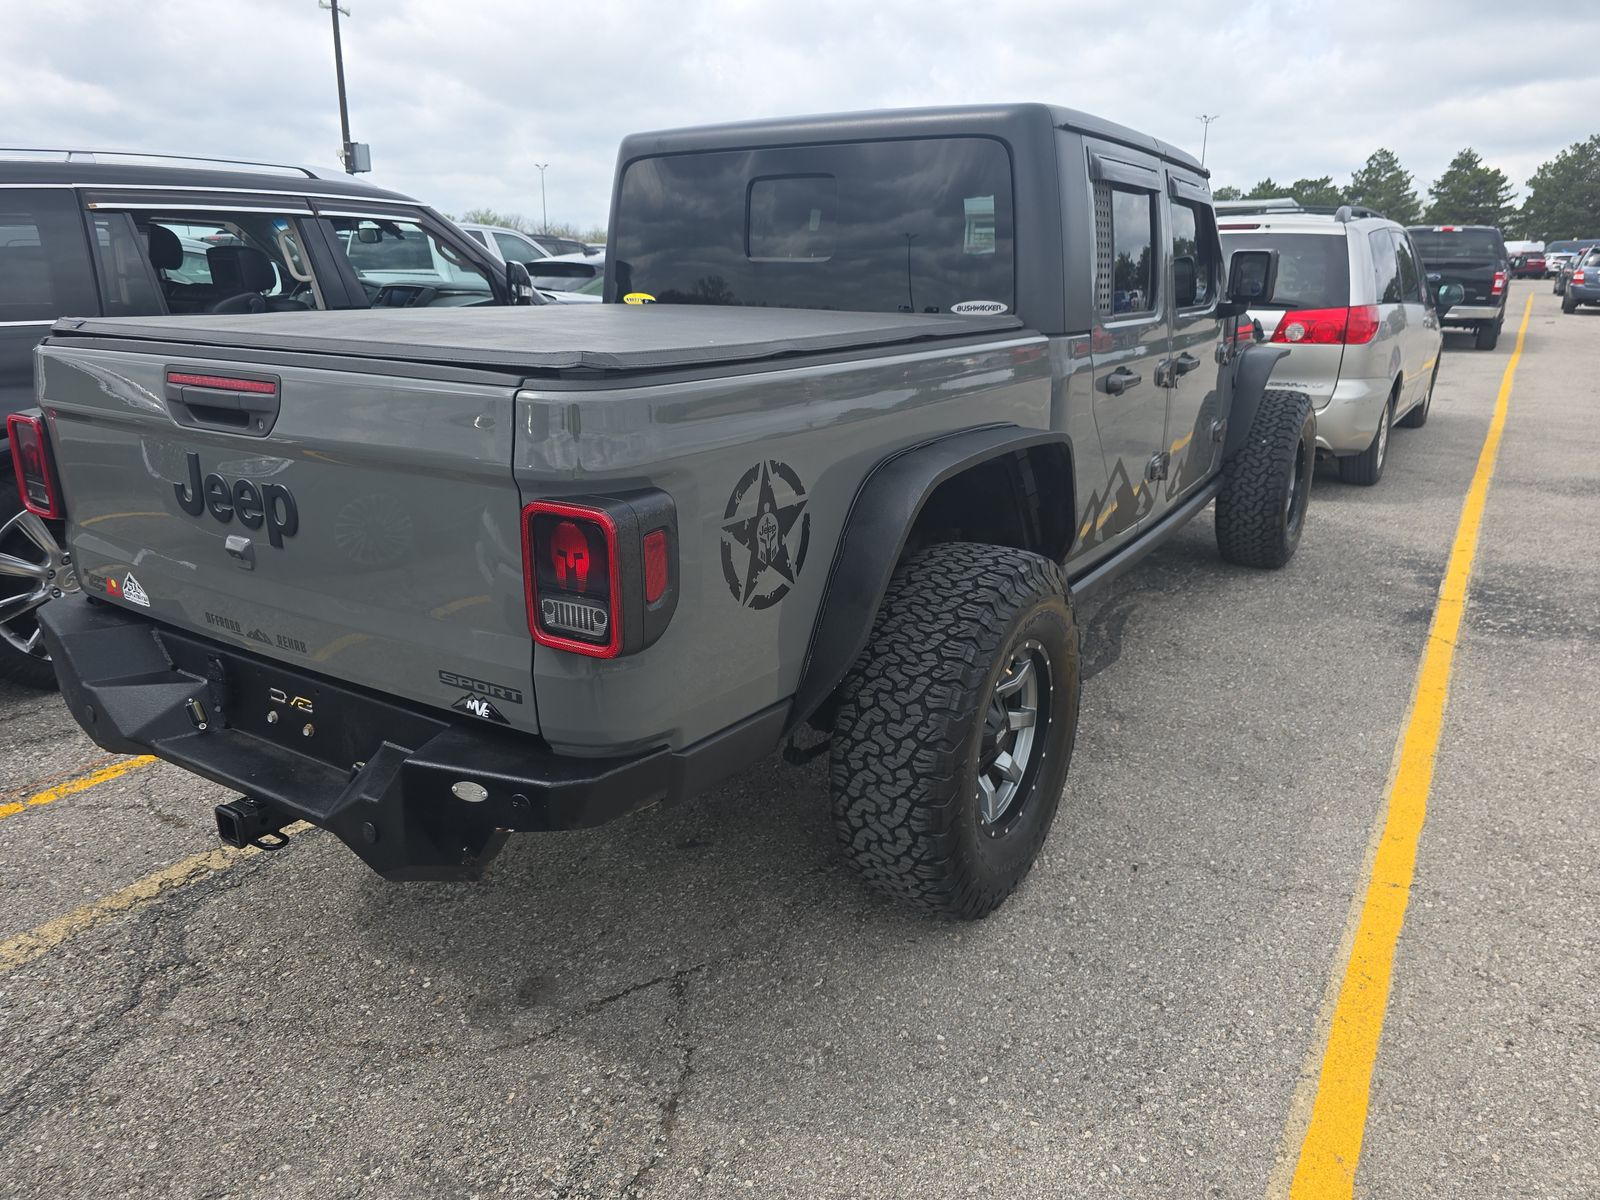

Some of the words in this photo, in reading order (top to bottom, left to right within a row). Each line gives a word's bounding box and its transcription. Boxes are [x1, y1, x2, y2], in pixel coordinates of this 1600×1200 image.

[956, 304, 1002, 312] BUSHWACKER
[173, 451, 299, 549] Jeep
[759, 524, 776, 536] Jeep
[205, 611, 242, 632] OFFROAD
[277, 634, 308, 653] REHAB
[440, 671, 521, 703] SPORT
